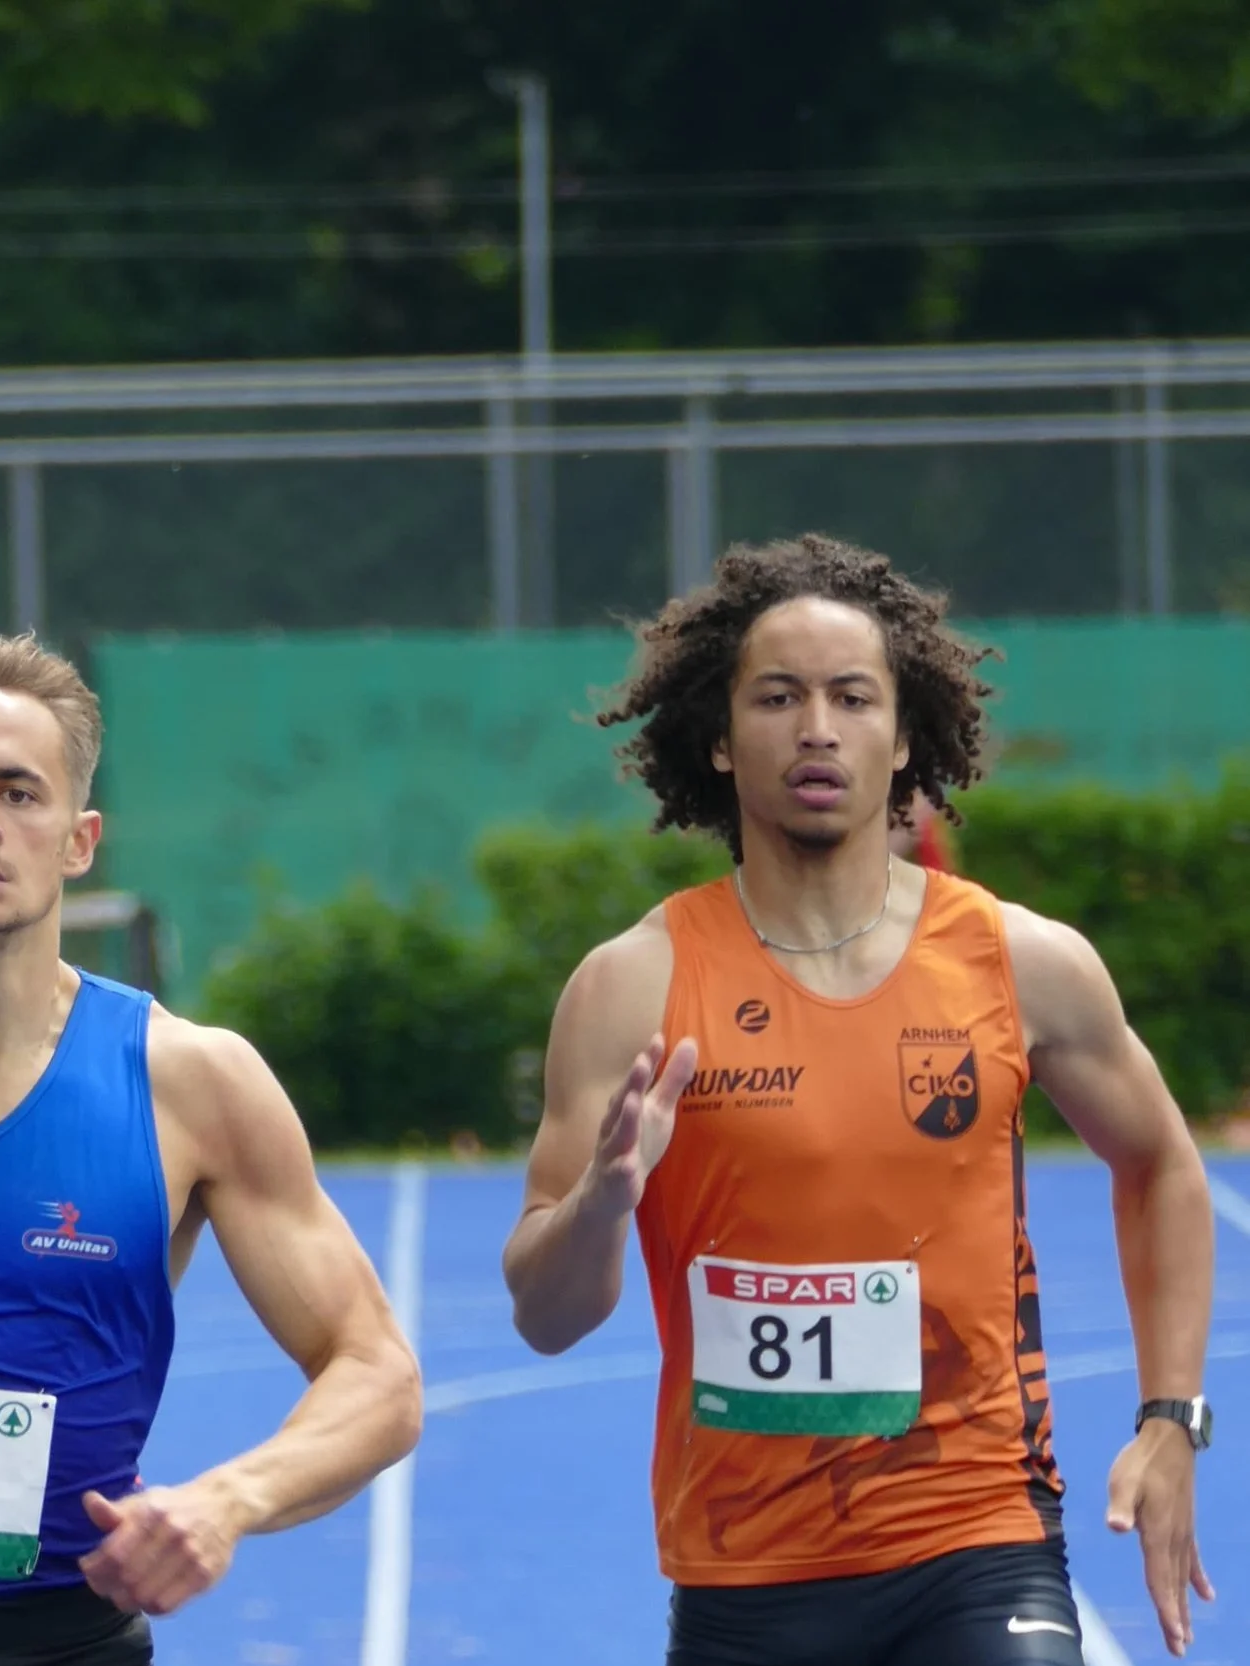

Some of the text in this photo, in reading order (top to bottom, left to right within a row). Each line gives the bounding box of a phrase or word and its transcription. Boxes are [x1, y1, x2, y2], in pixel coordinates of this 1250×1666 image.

[900, 1027, 970, 1042] ARNHEM
[908, 1074, 975, 1098] CIKO
[31, 1235, 110, 1255] AV Unitas
[733, 1273, 853, 1301] SPAR
[749, 1314, 833, 1381] 81
